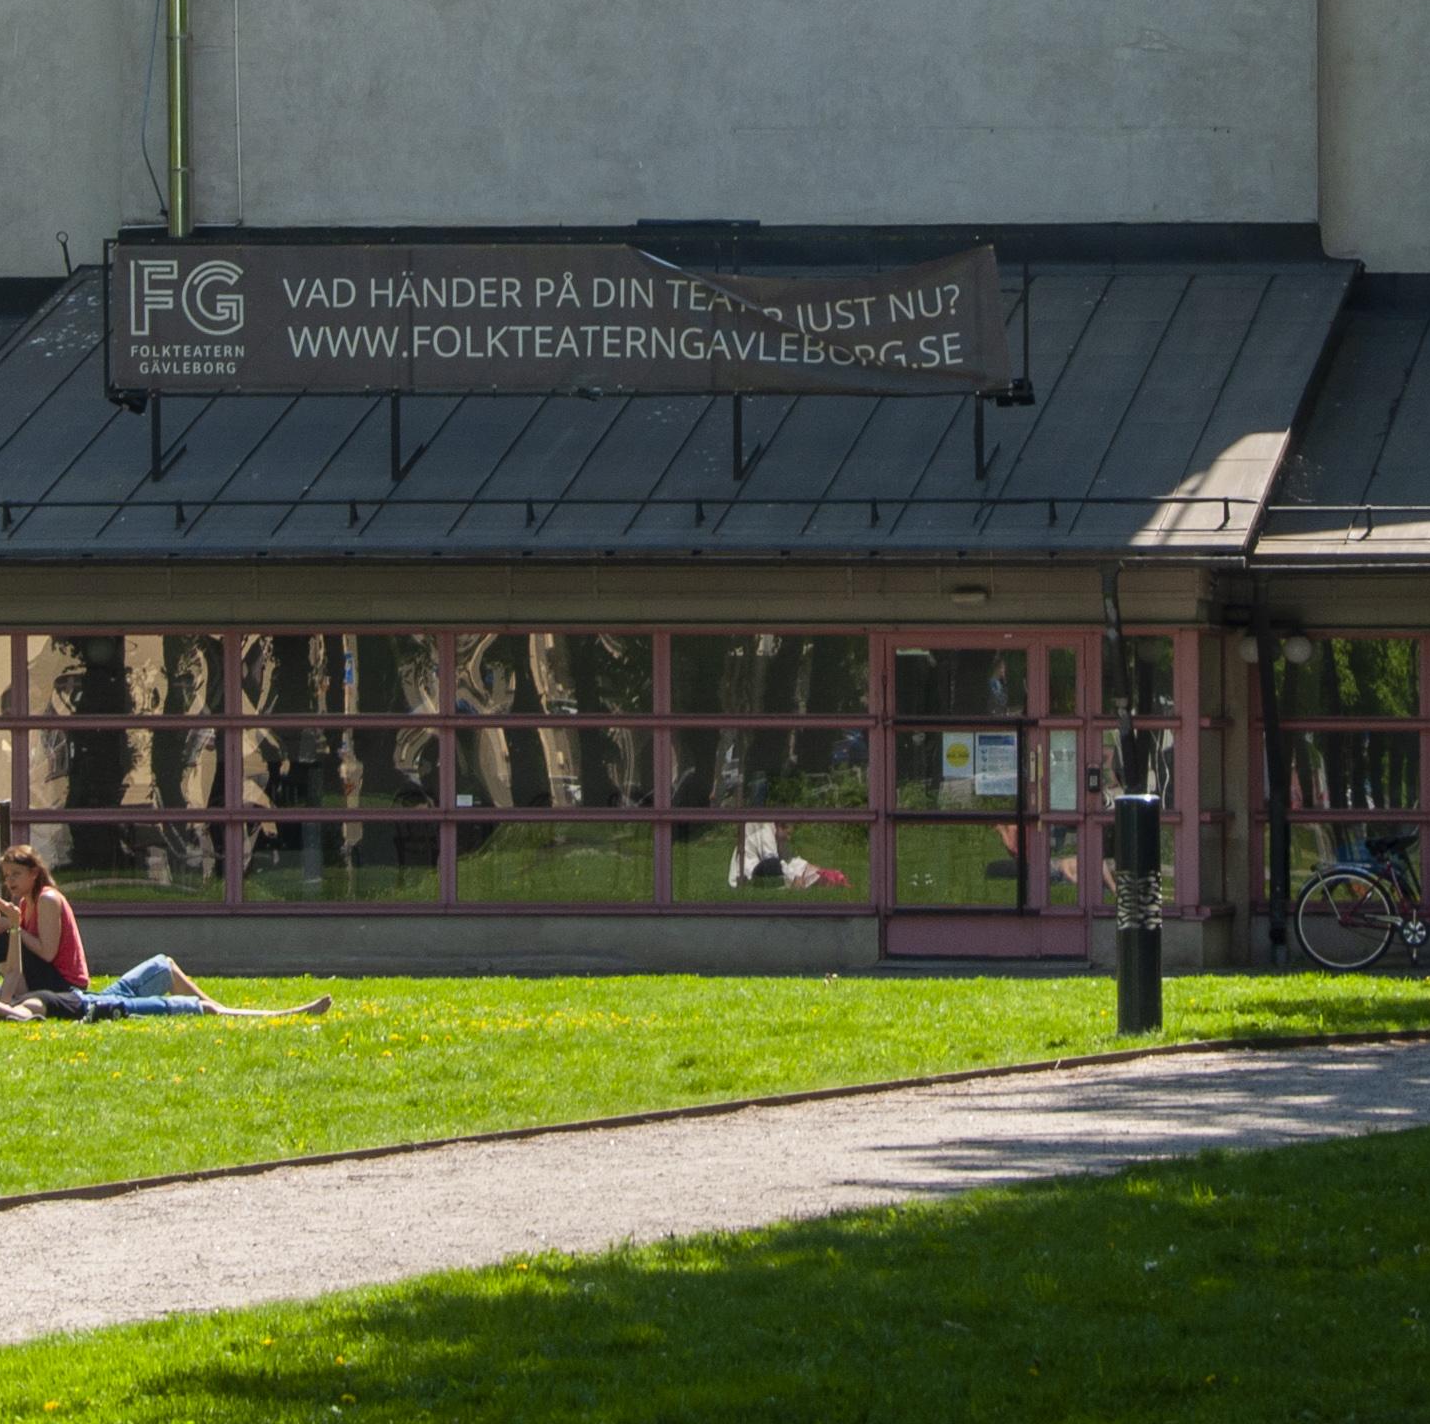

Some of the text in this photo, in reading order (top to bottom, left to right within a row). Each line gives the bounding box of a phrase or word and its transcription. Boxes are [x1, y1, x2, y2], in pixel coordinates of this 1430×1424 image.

[129, 259, 244, 336] FG
[282, 277, 356, 308] VAD
[370, 270, 522, 308] HÄNDER
[535, 271, 581, 308] PÅ
[592, 277, 653, 308] DIN
[796, 297, 876, 334] JUST
[889, 284, 960, 323] NU?
[130, 345, 245, 358] FOLKTEATERN
[139, 359, 236, 374] GÄVLEBORG
